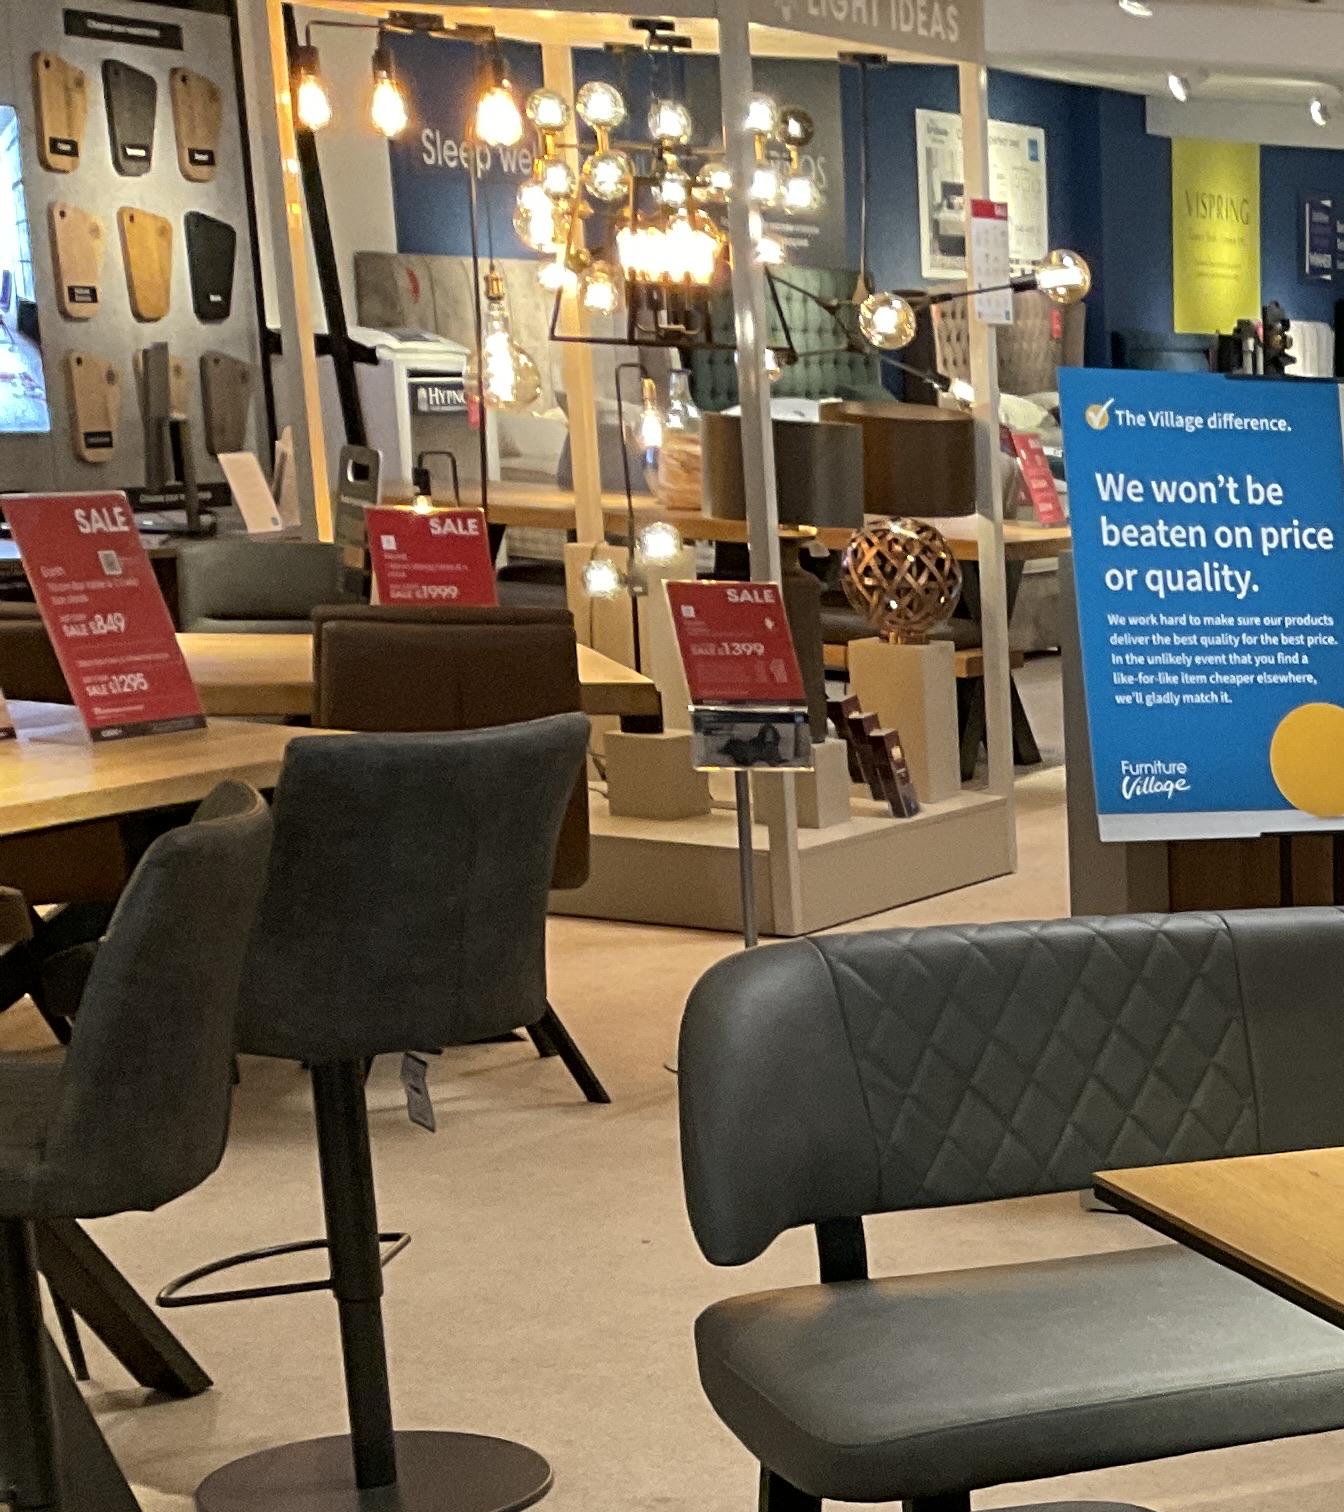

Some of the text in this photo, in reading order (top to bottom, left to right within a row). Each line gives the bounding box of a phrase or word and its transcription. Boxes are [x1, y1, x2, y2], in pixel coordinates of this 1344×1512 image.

[891, 0, 959, 43] IDEAS
[421, 129, 491, 178] Sleep
[428, 387, 467, 405] HYPN
[1115, 410, 1292, 432] The Village difference.
[1095, 473, 1283, 505] We won't be
[74, 506, 129, 534] SALE
[429, 518, 480, 536] SALE
[1100, 516, 1334, 556] beaten on price
[1104, 562, 1259, 599] or quality.
[726, 588, 775, 604] SALE
[1107, 613, 1334, 628] We work hard to make sure our products
[1109, 633, 1338, 648] deliver the best quality for the best price.
[1111, 652, 1308, 667] In the unlikely event that you find a
[1113, 672, 1318, 687] like-for-like item cheaper elsewhere,
[1145, 692, 1180, 706] gladly
[1182, 692, 1218, 704] match
[1220, 691, 1233, 704] it.
[1121, 760, 1188, 776] Furniture
[1121, 776, 1191, 800] Village
